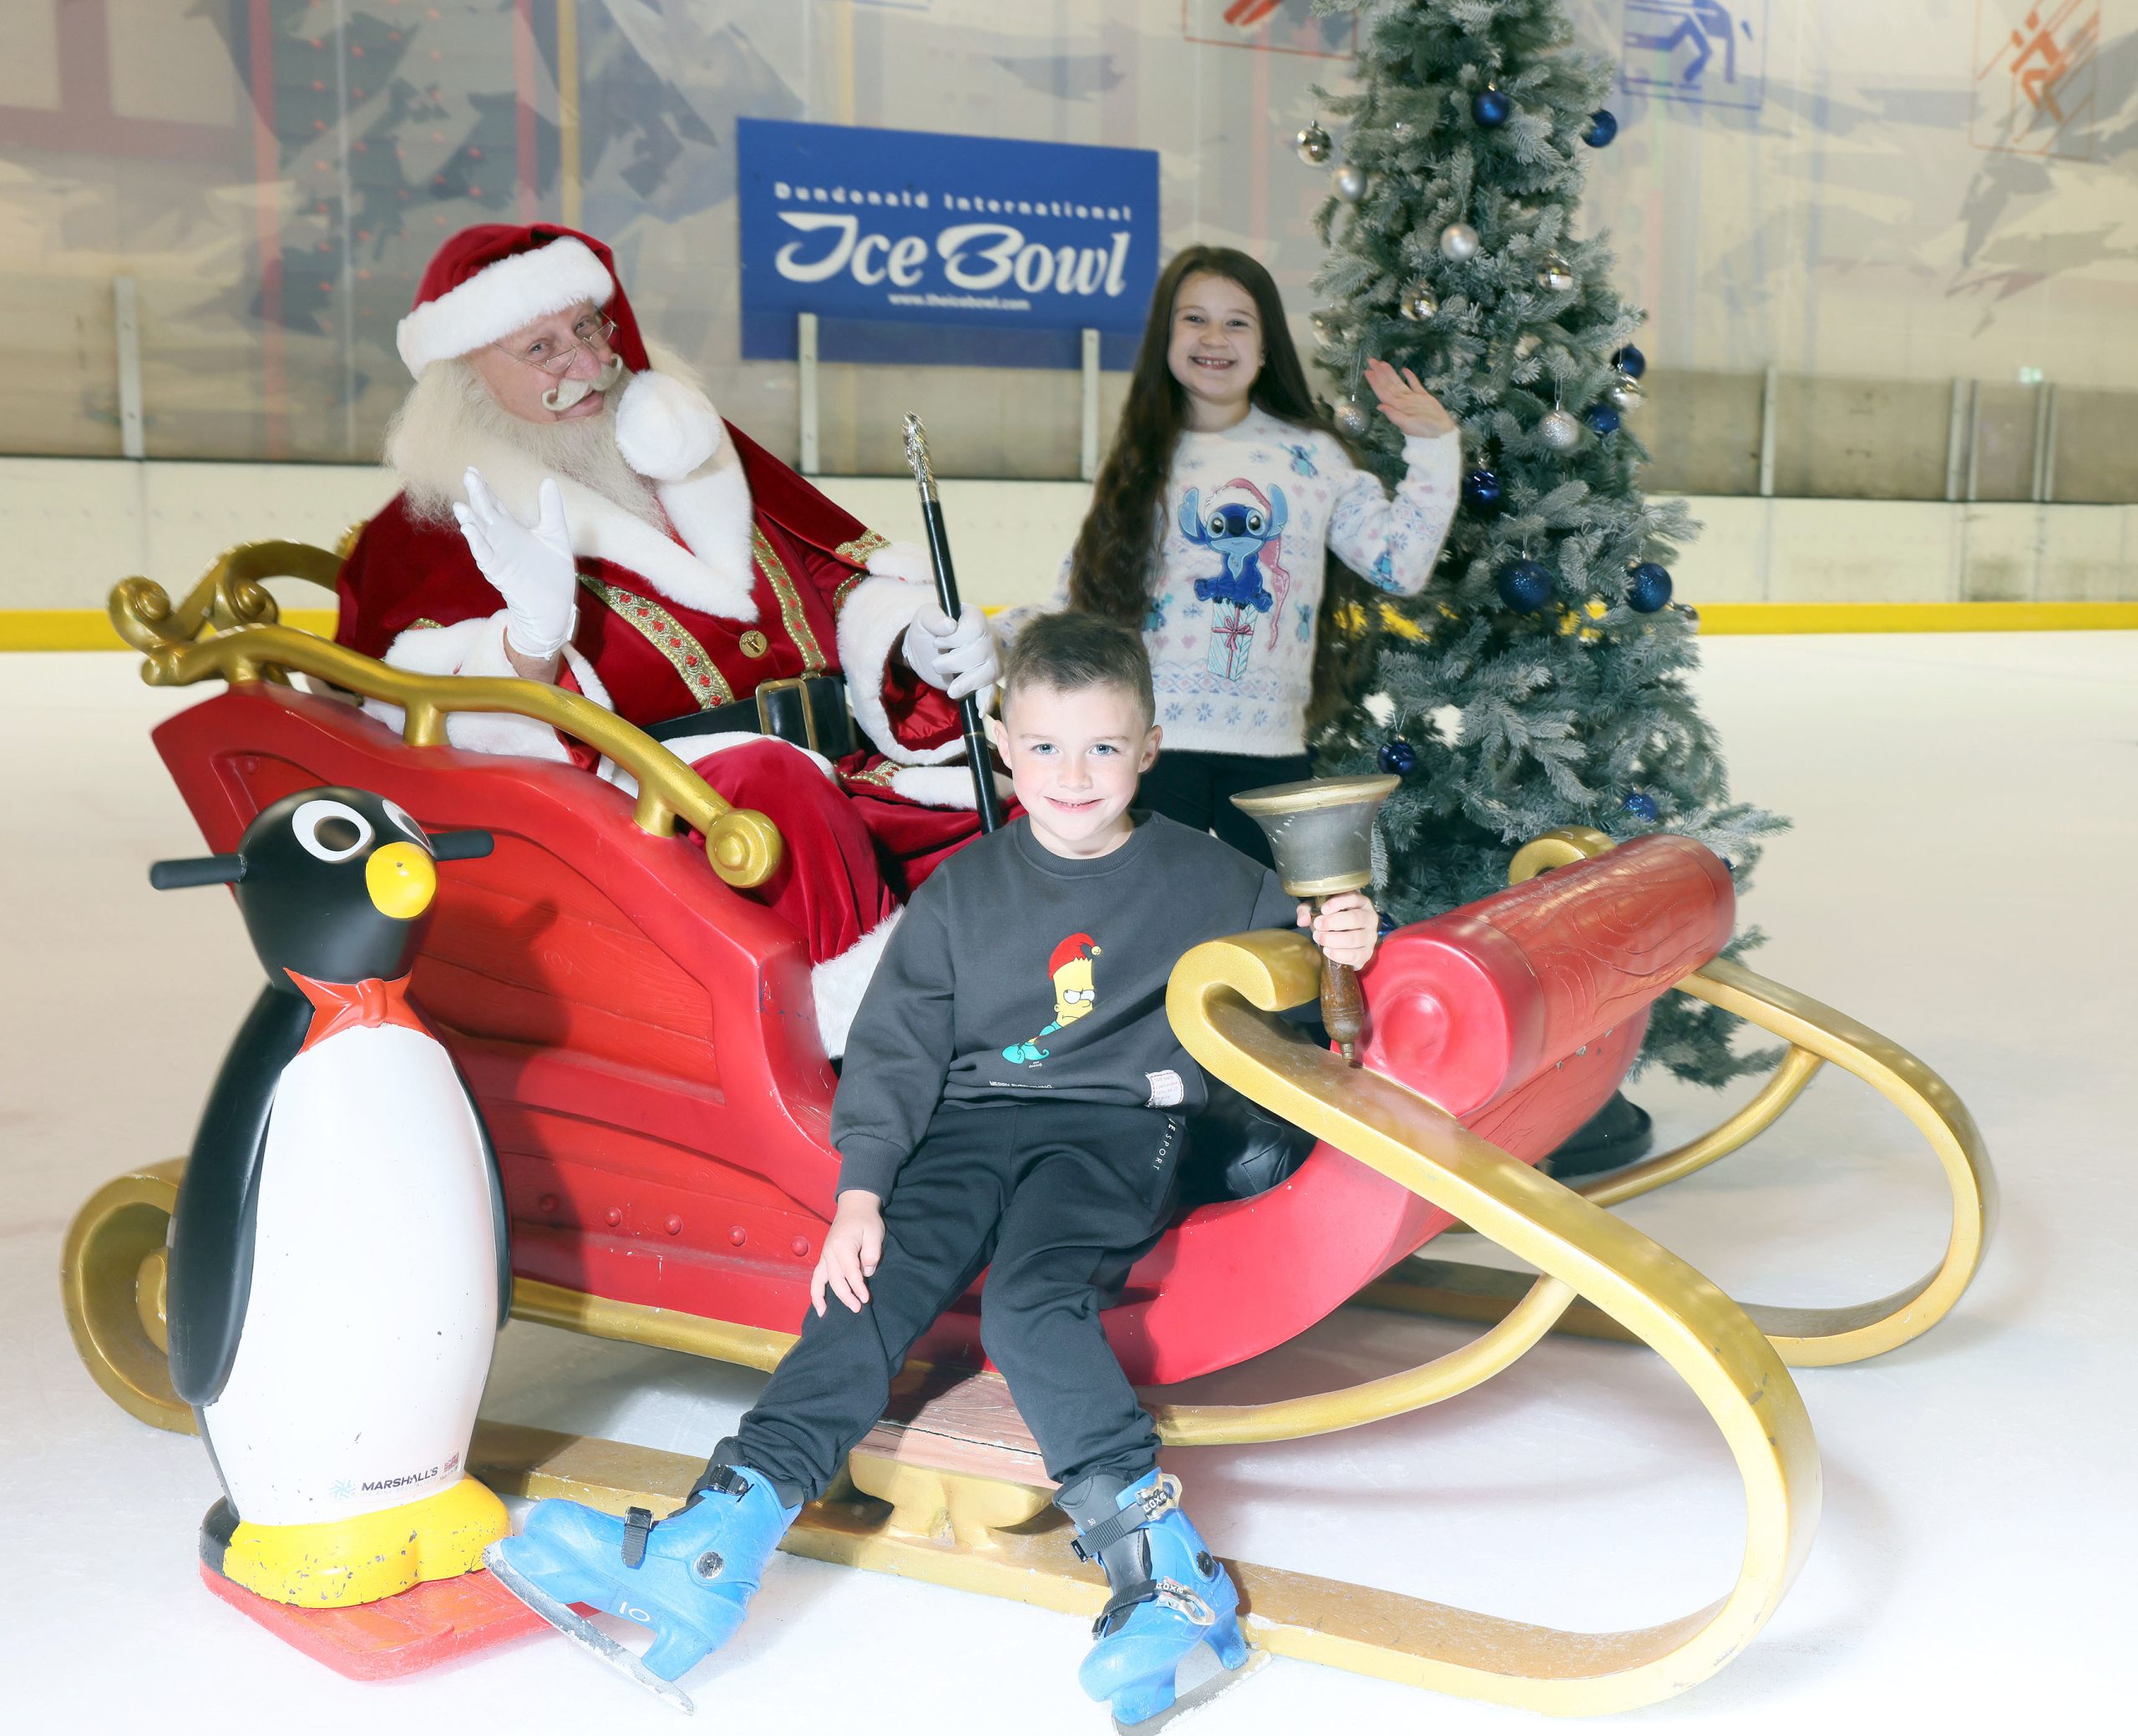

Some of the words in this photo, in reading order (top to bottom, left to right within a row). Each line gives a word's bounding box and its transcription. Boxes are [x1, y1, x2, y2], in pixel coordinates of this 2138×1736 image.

[774, 181, 929, 209] Dundonald
[944, 193, 1132, 222] International
[936, 223, 1131, 297] Bowl
[1153, 1133, 1173, 1171] SPORT
